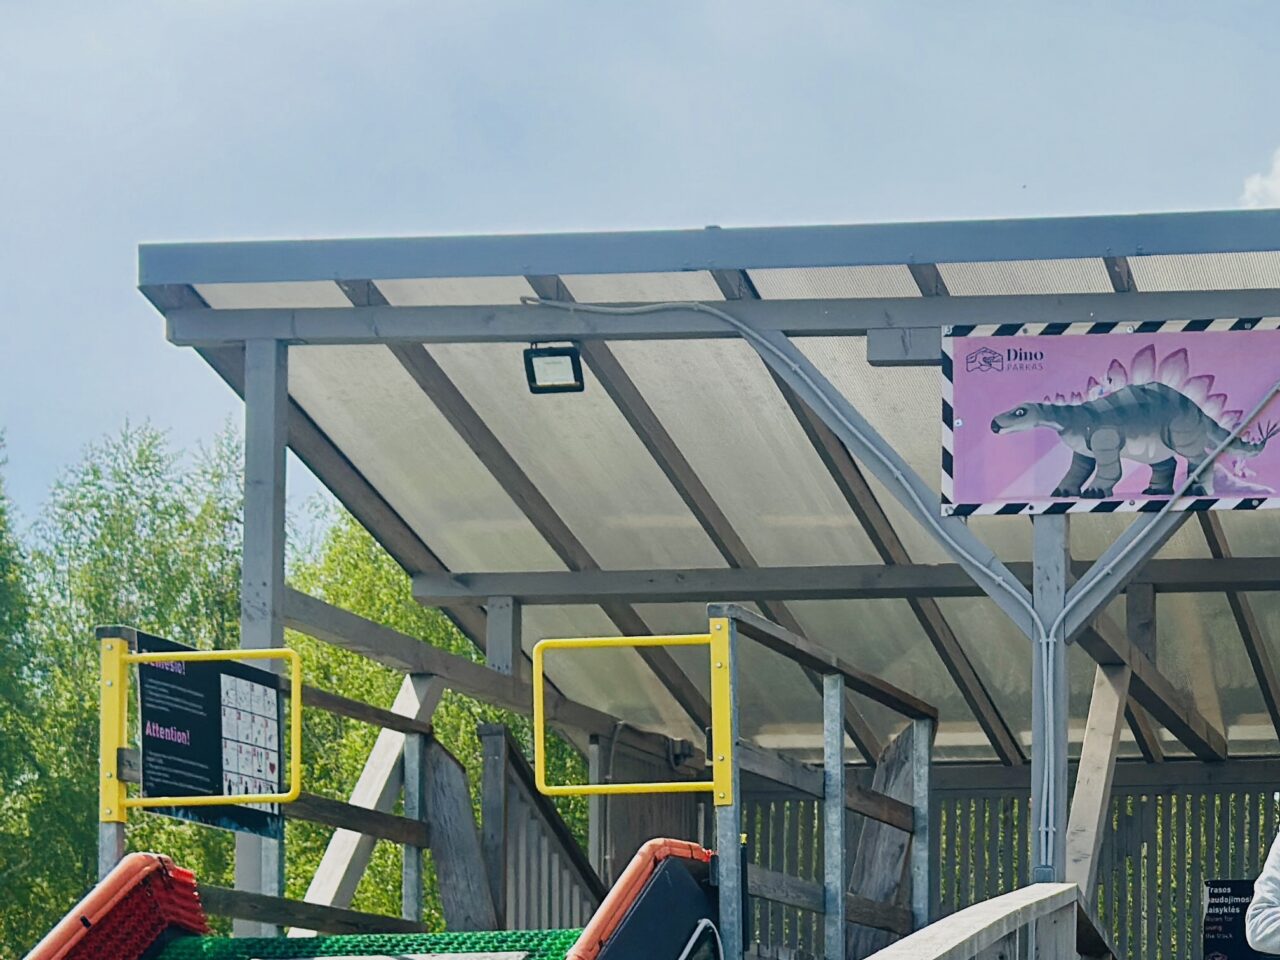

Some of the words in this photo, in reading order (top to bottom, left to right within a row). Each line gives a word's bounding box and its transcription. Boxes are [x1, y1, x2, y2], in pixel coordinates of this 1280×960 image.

[1007, 348, 1044, 361] Dino
[1007, 363, 1044, 371] PARKAS
[145, 720, 190, 746] Attention!
